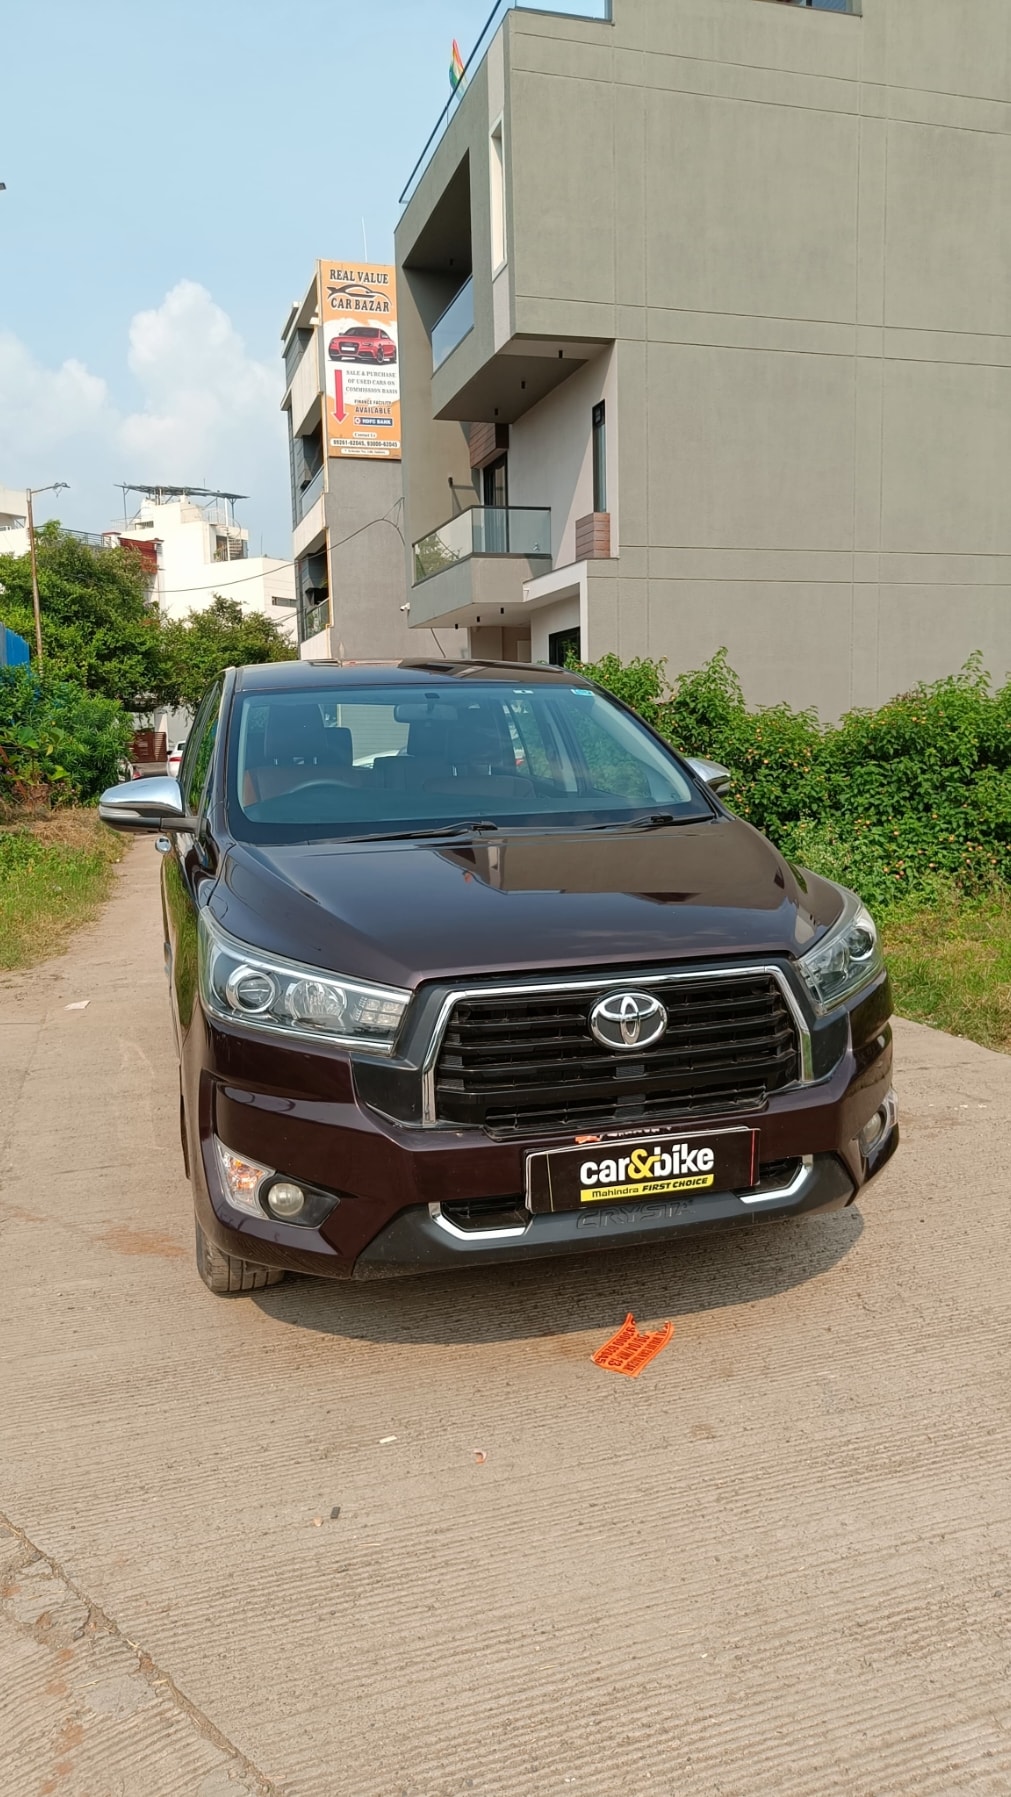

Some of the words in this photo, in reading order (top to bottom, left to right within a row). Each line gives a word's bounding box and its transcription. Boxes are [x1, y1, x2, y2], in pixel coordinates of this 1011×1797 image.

[330, 269, 355, 281] REAL
[357, 271, 389, 284] VALUE
[331, 298, 352, 309] CAR
[354, 299, 390, 312] BAZAR
[345, 386, 381, 394] COMMISSION
[355, 406, 391, 414] AVAILABLE
[580, 1143, 714, 1185] car&bike
[592, 1186, 639, 1198] Mahindra
[642, 1181, 671, 1192] FIRST
[672, 1177, 708, 1188] CHOICE
[576, 1200, 695, 1229] CRYSTA
